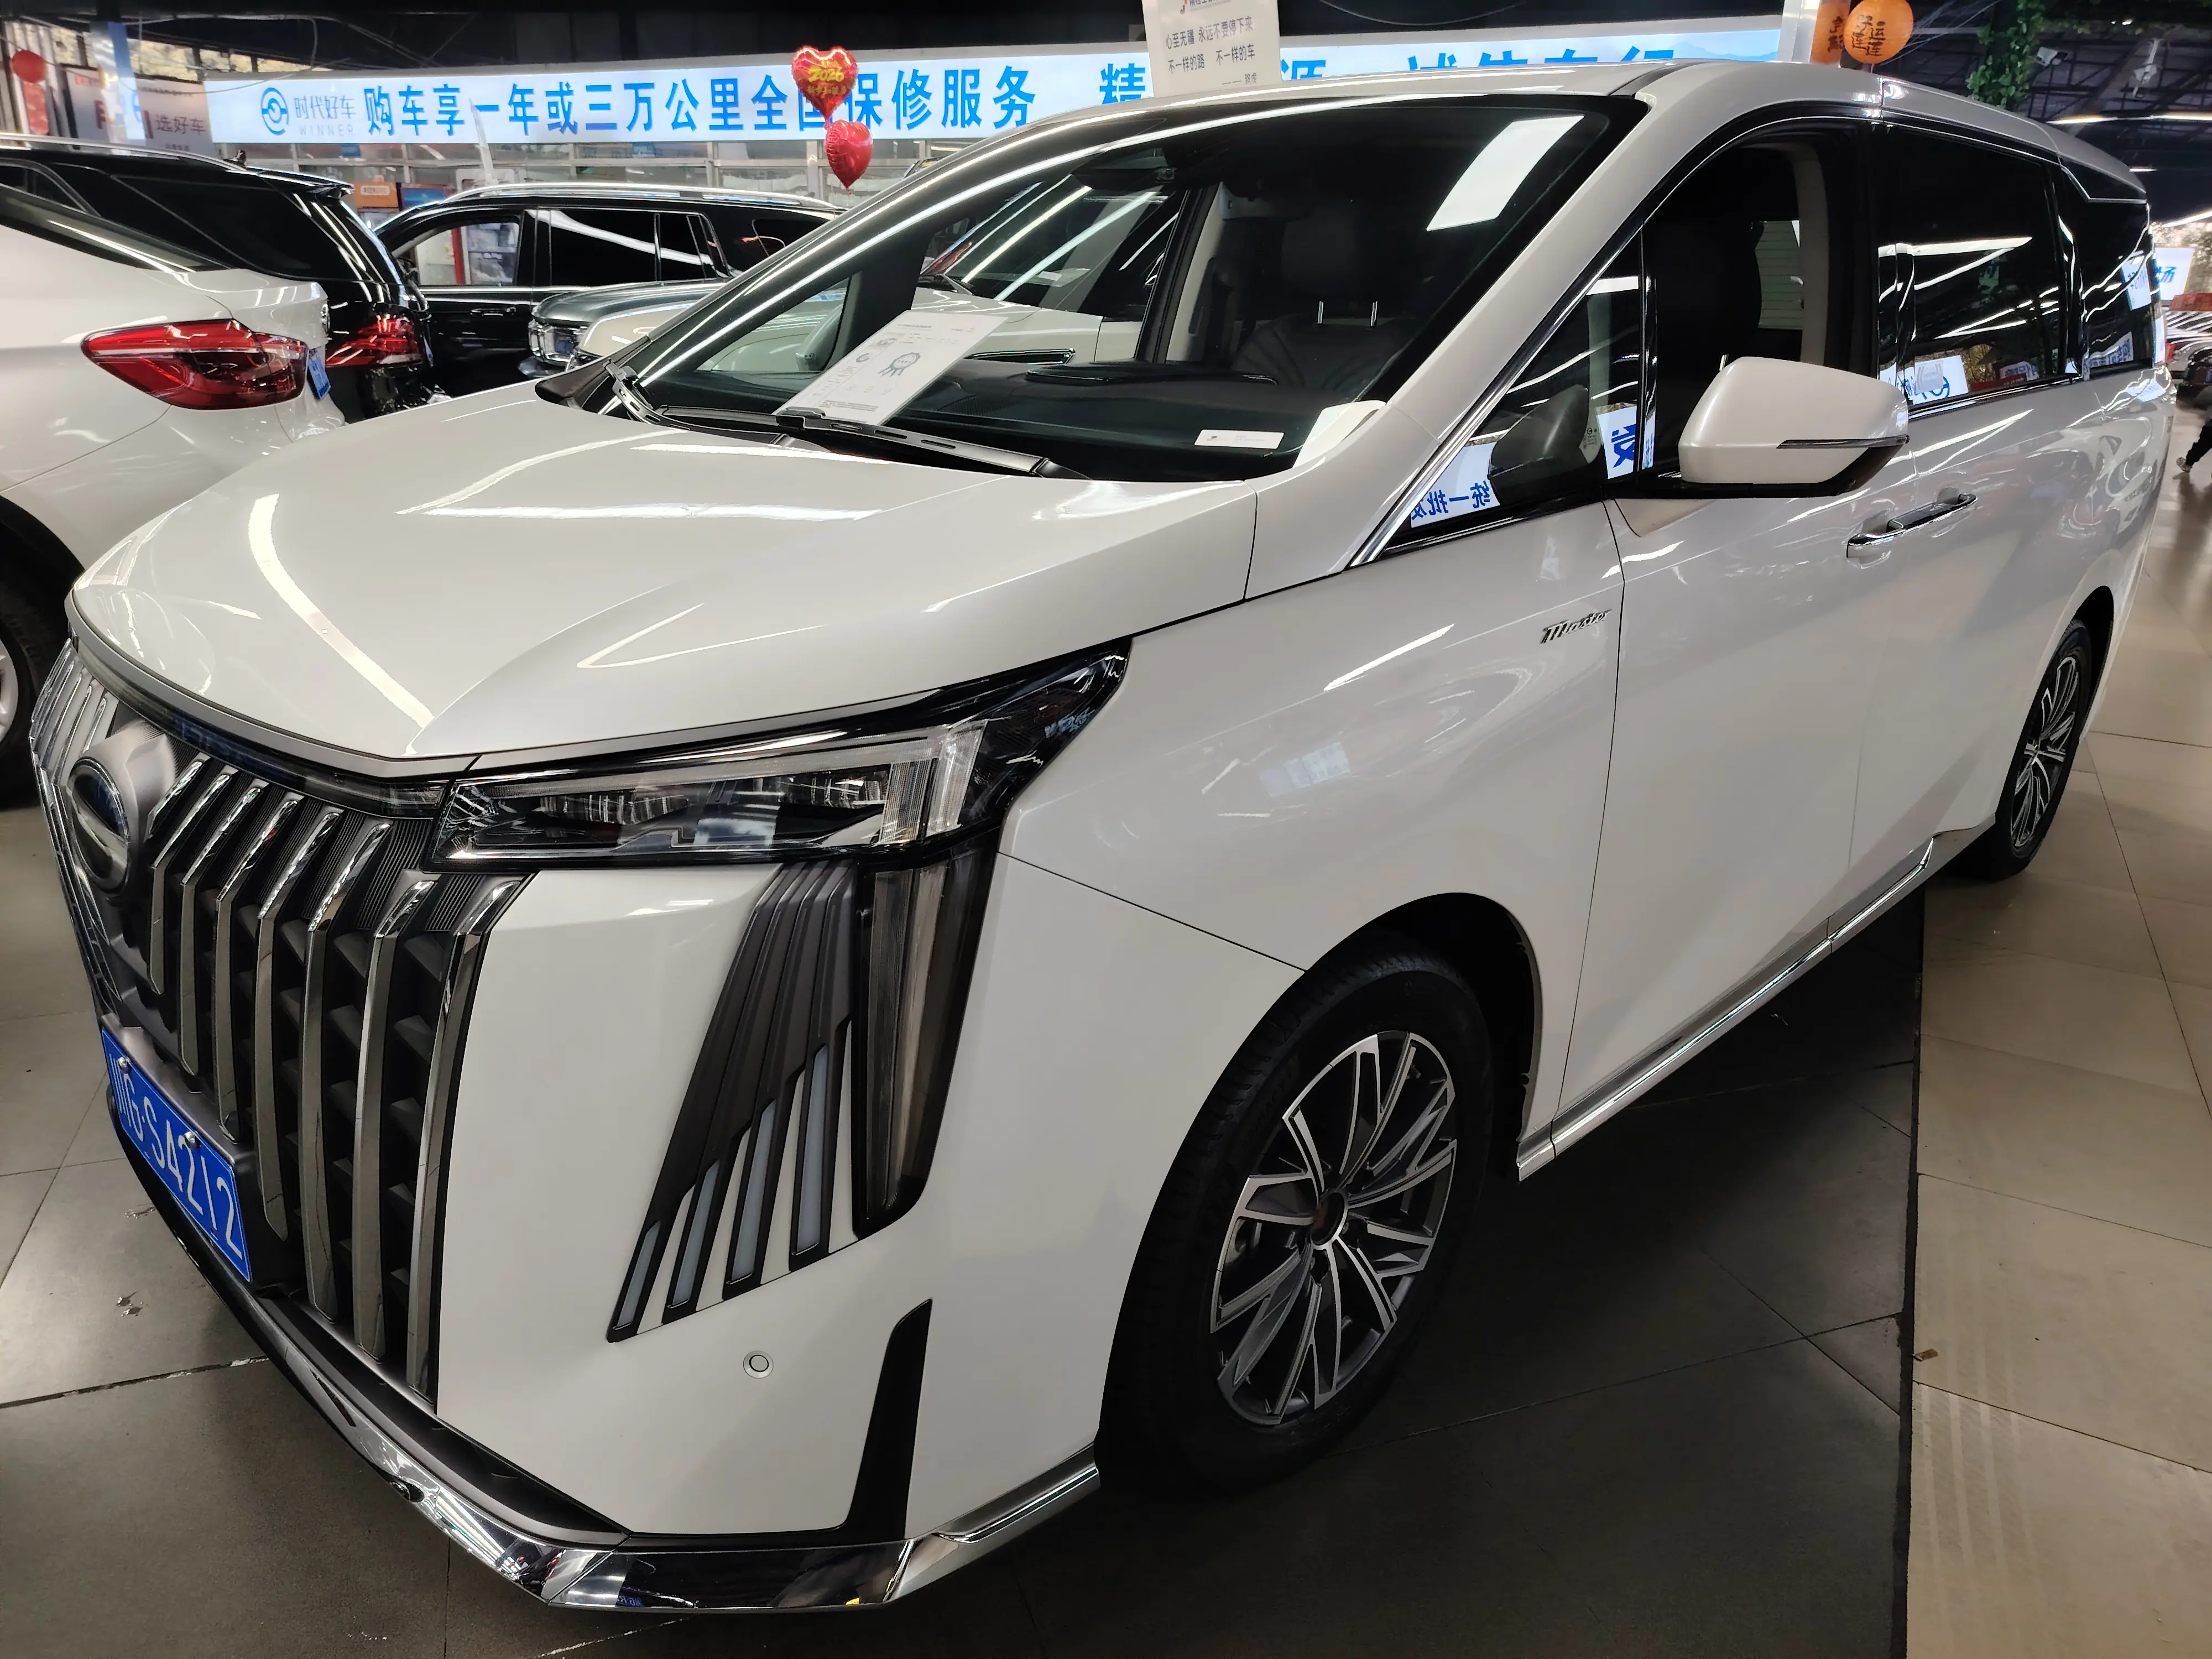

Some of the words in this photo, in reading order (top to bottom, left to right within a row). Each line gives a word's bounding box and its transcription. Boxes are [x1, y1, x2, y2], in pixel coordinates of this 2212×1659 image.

[1165, 29, 1195, 49] 心至无疆
[1198, 15, 1253, 43] 永远不要停下来
[1167, 54, 1205, 75] 不一样的路
[1215, 43, 1255, 66] 不一样的车
[294, 95, 357, 120] 时代好车
[363, 65, 1036, 137] 购车享一年或三万公里全保修服务
[155, 113, 206, 135] 选好车
[299, 124, 354, 137] WINNER
